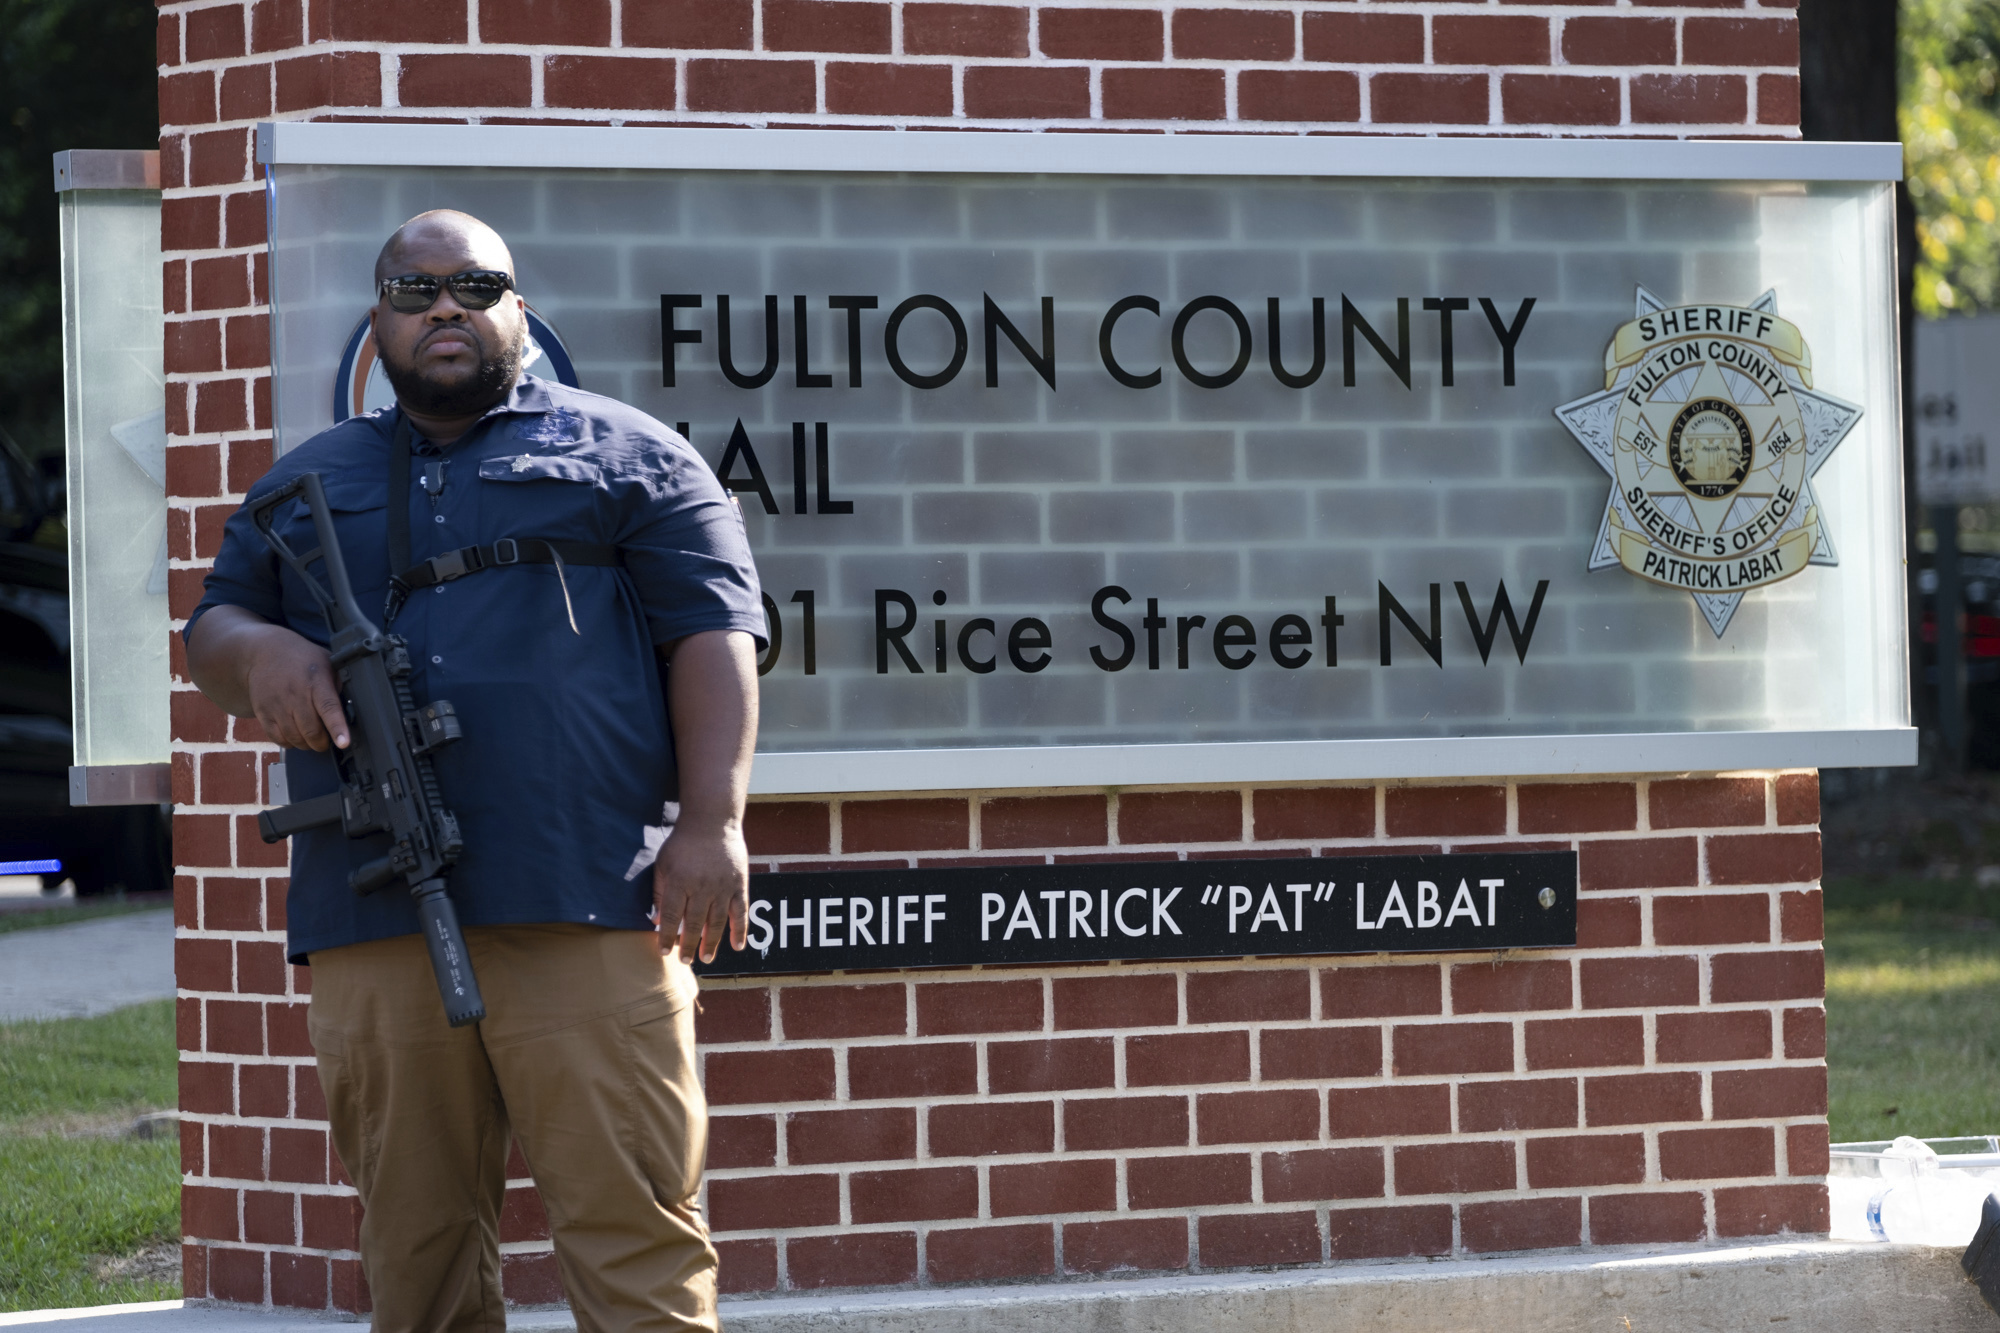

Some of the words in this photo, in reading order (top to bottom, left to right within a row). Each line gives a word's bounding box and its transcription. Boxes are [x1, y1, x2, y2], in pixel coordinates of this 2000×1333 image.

[660, 291, 1056, 392] FULTON
[1099, 292, 1537, 391] COUNTY
[1638, 308, 1774, 341] SHERIFF
[1627, 341, 1701, 407] FULTON
[1708, 341, 1787, 399] COUNTY
[1633, 430, 1657, 458] EST.
[1671, 414, 1690, 460] STATE
[1691, 401, 1706, 413] OF
[1711, 400, 1750, 459] GEORGIA
[1767, 431, 1792, 458] 1854
[677, 417, 854, 515] AIL
[1700, 485, 1725, 496] 1776
[1627, 486, 1726, 556] SHERIFF'S
[1732, 484, 1795, 550] OFFICE
[1643, 551, 1722, 588] PATRICK
[1727, 549, 1784, 587] LABAT
[875, 588, 1053, 674] Rice
[1089, 585, 1345, 672] Street
[1378, 577, 1550, 670] NW
[746, 894, 947, 951] SHERIFF
[981, 887, 1183, 941] PATRICK
[1356, 878, 1505, 931] LABAT
